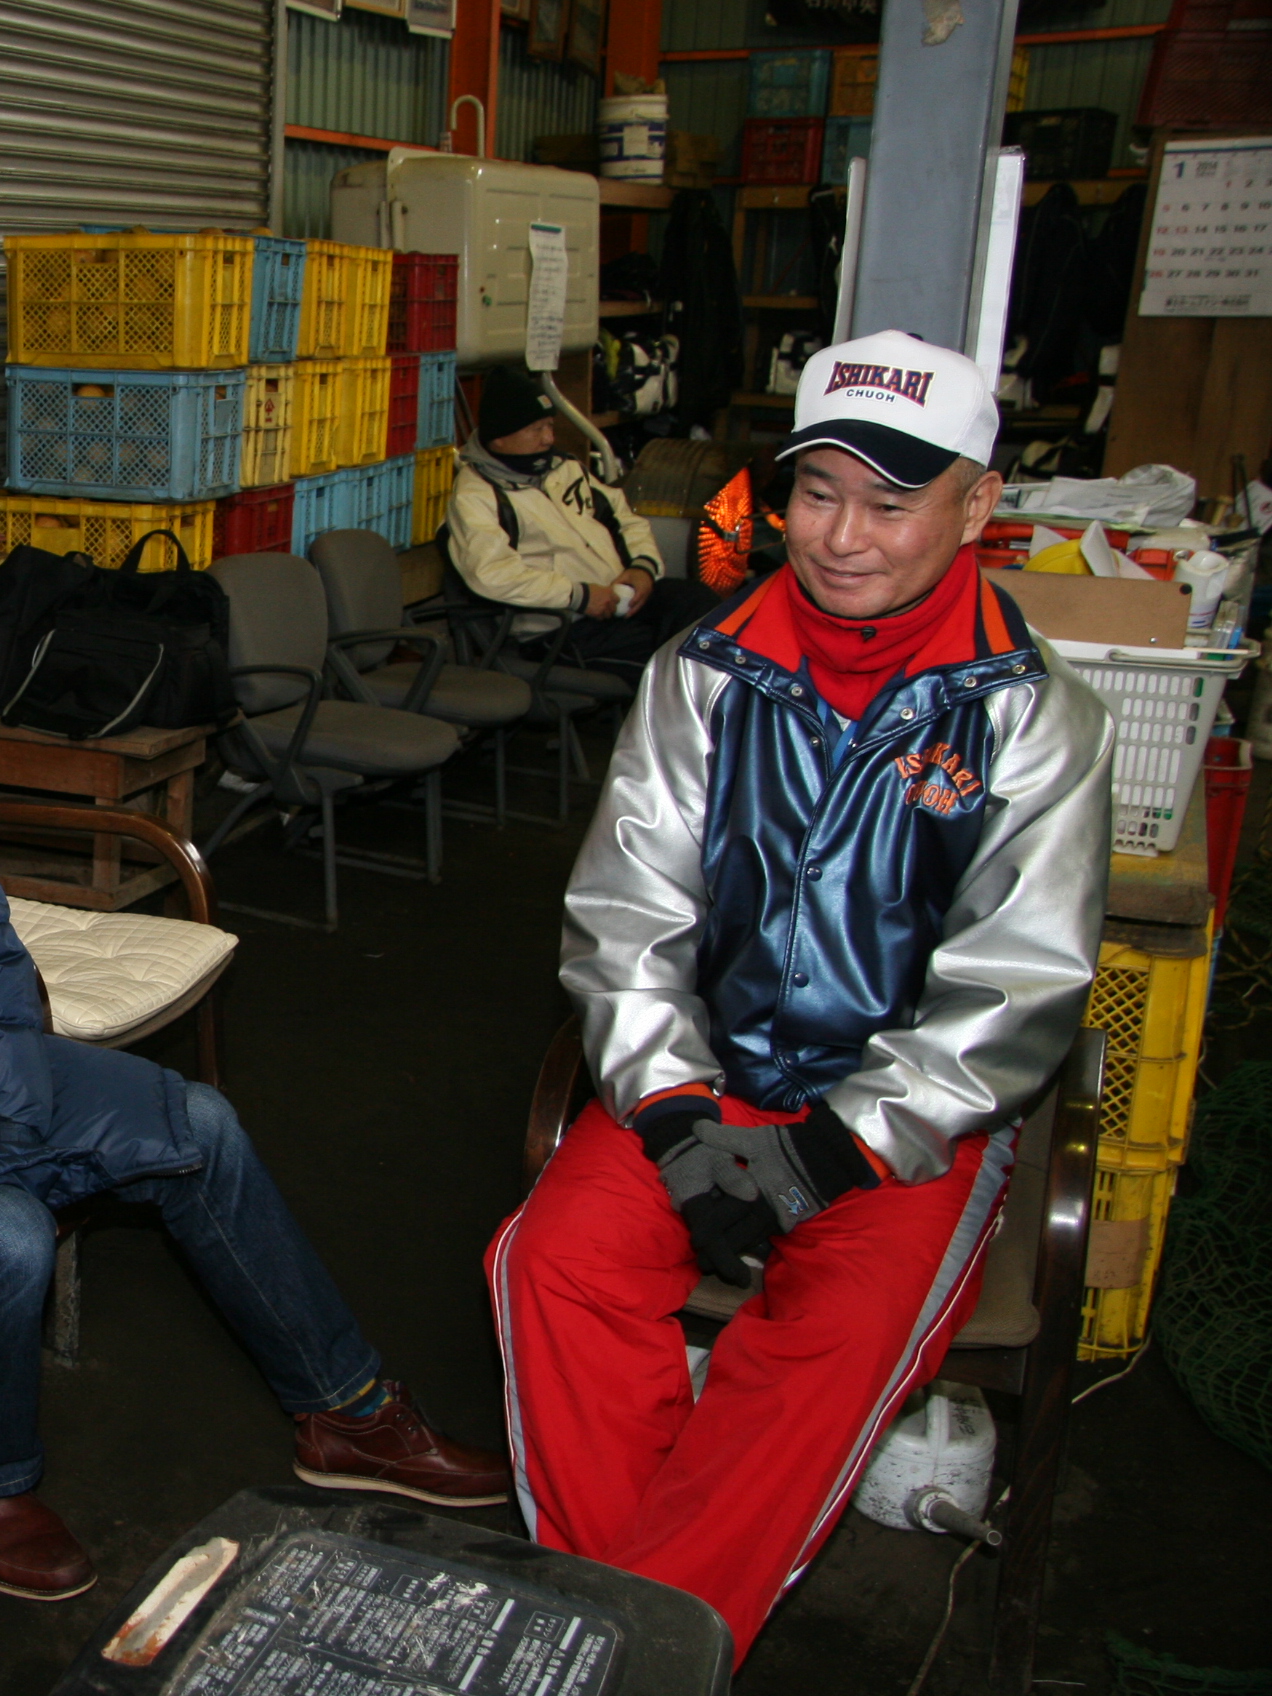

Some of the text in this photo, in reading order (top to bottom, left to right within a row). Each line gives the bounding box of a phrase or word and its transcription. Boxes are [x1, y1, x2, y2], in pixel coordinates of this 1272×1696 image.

[1173, 160, 1186, 179] 1
[1181, 202, 1191, 212] 6
[1194, 225, 1208, 234] 14
[823, 360, 935, 408] ISHIKARI
[845, 388, 896, 403] CHUOH
